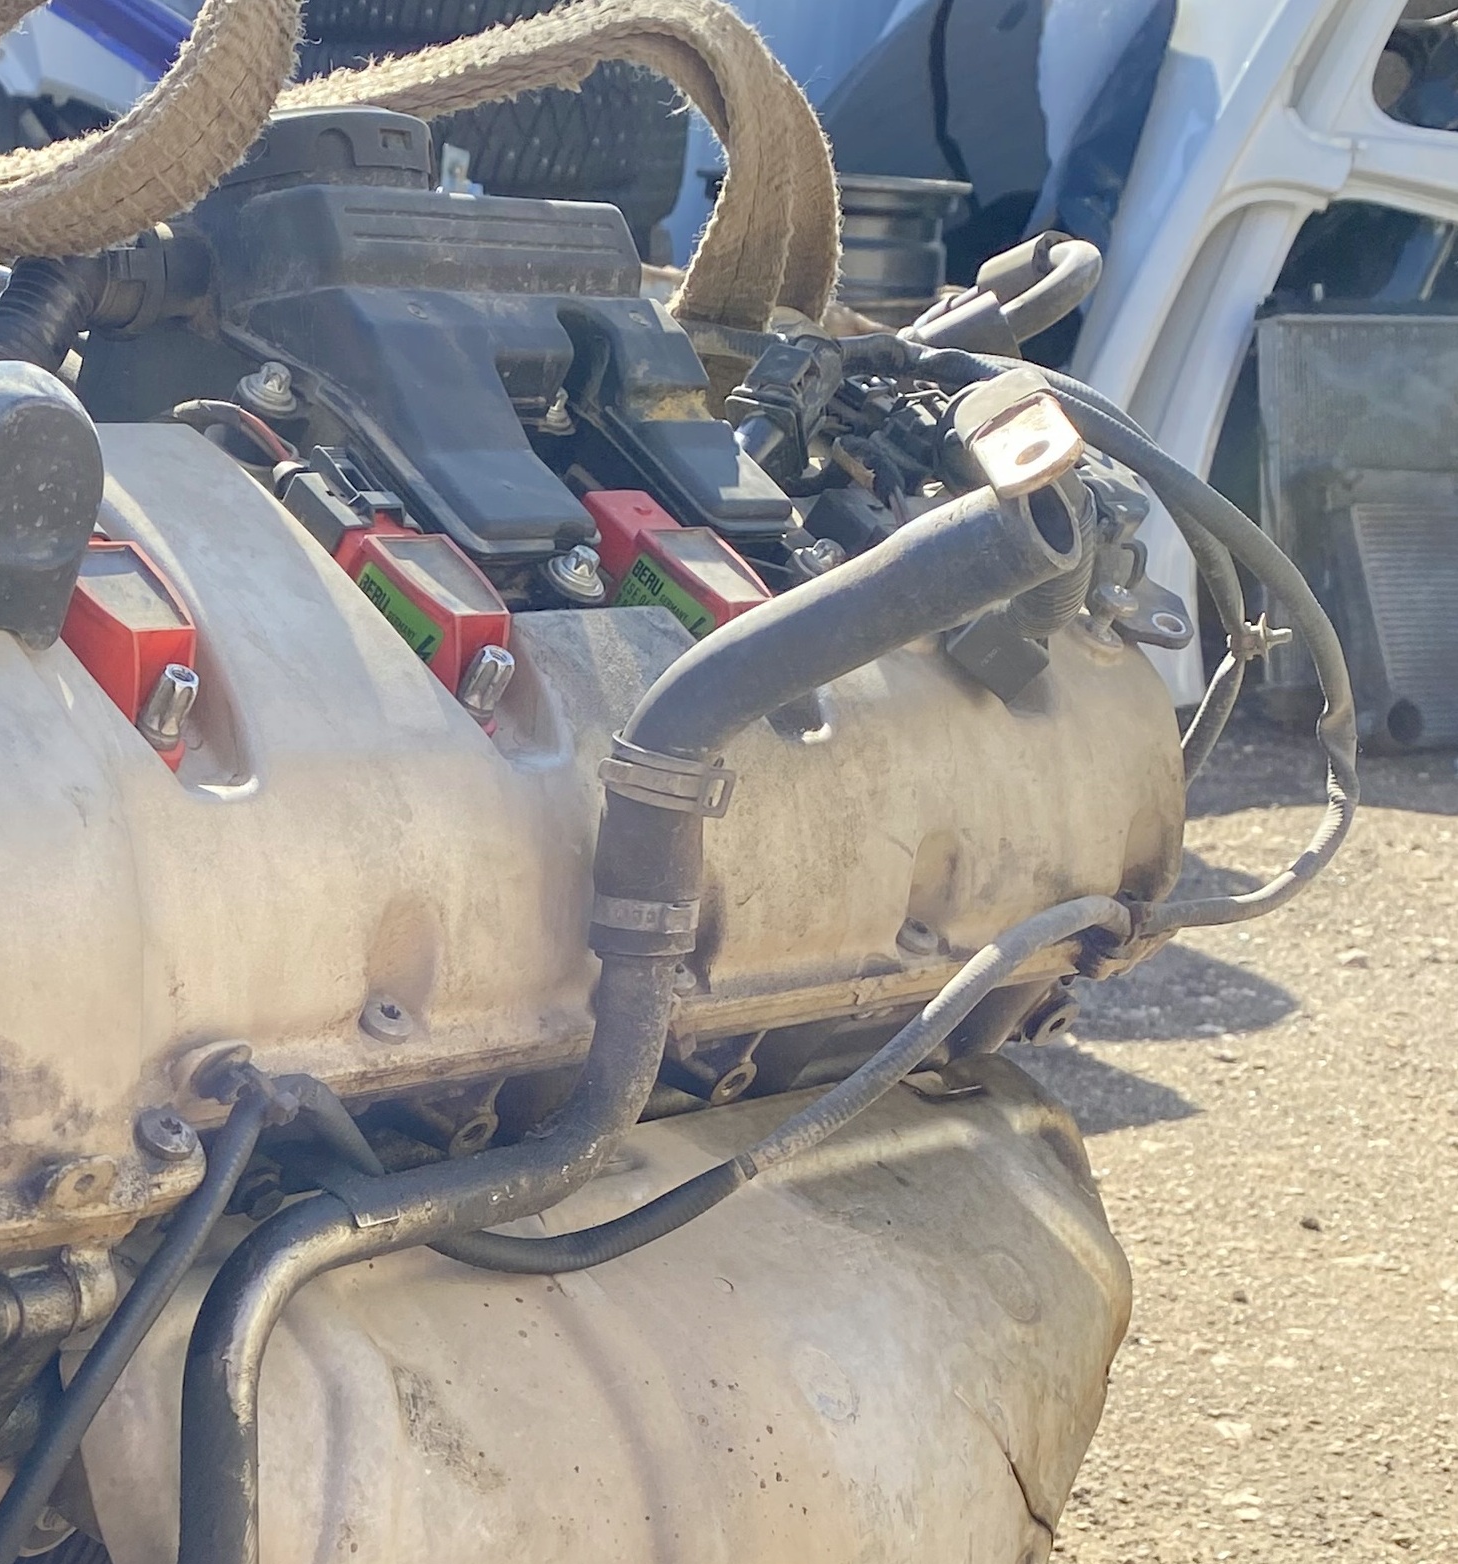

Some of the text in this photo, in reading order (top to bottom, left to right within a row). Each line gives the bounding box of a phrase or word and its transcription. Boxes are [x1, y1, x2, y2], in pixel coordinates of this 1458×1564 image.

[359, 572, 391, 613] BERU
[631, 559, 689, 622] BERU GERMANY
